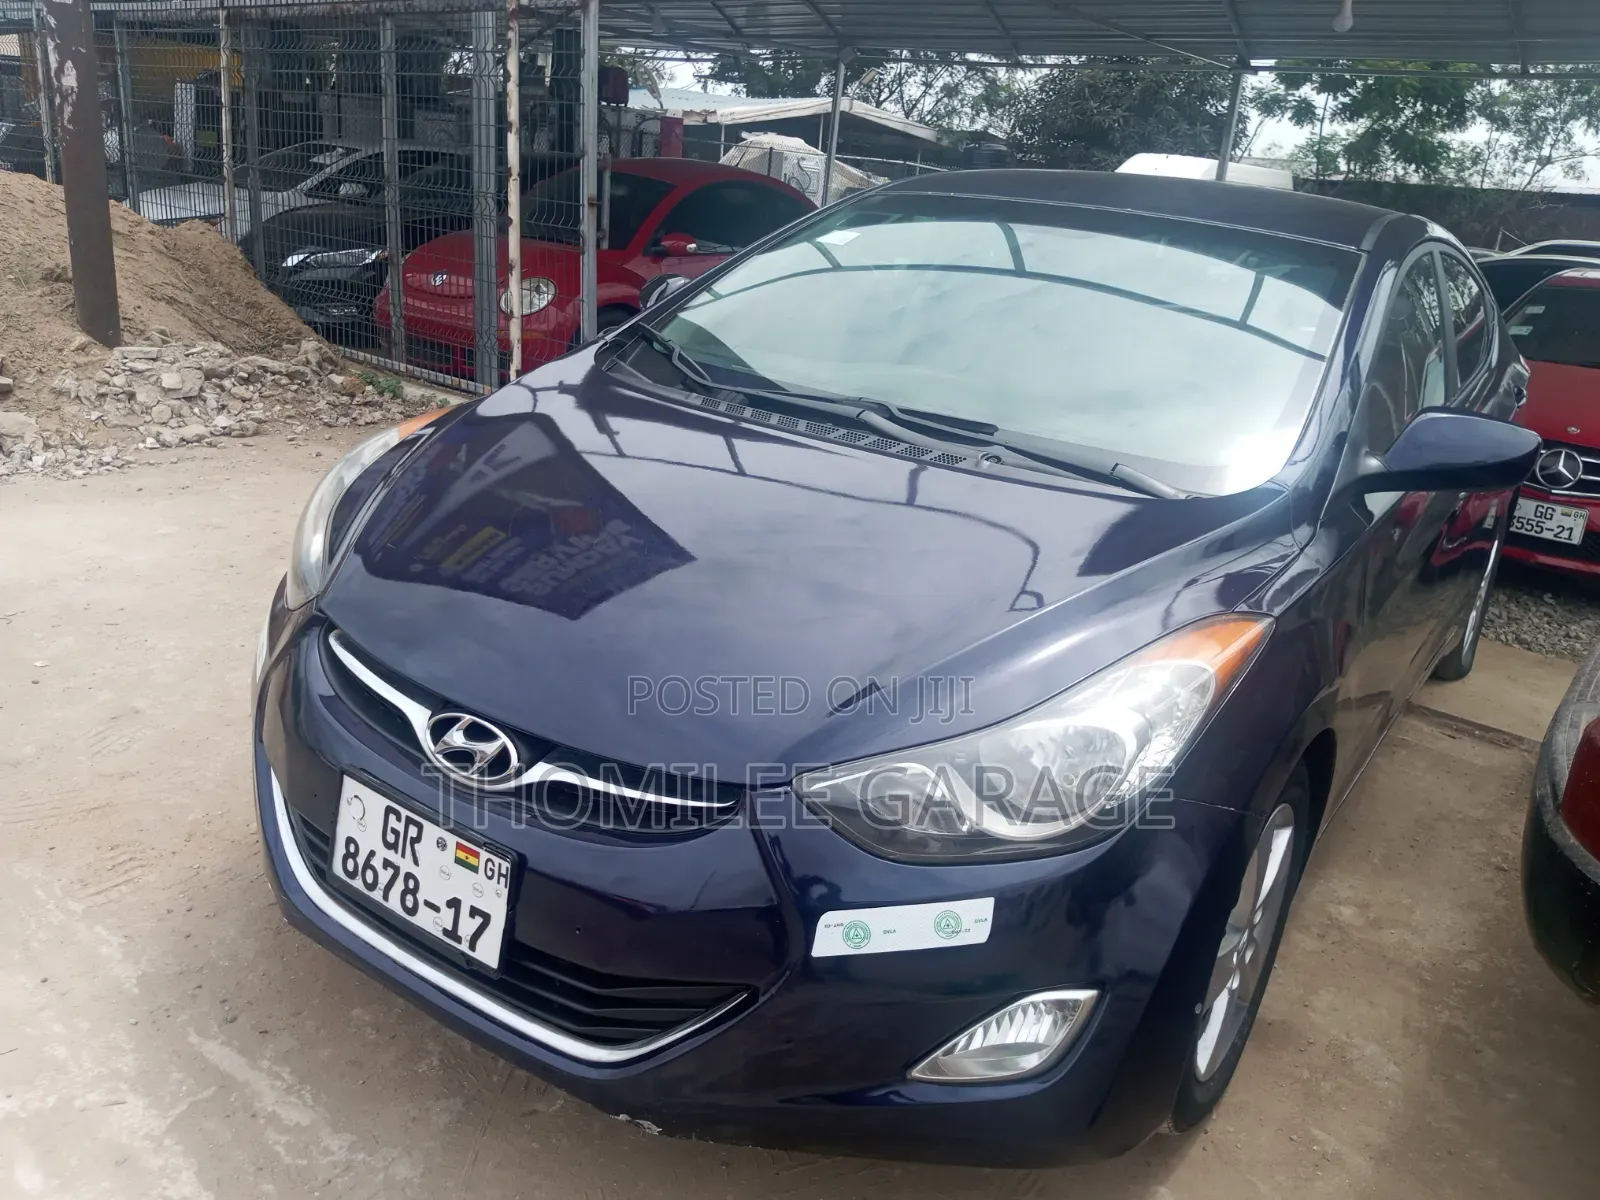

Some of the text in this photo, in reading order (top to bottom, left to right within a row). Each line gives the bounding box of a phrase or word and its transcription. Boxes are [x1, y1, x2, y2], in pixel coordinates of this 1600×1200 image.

[1534, 504, 1556, 521] GG
[1573, 511, 1585, 520] GH
[382, 804, 424, 867] GR
[483, 857, 510, 890] GH
[341, 835, 492, 953] 8678-17
